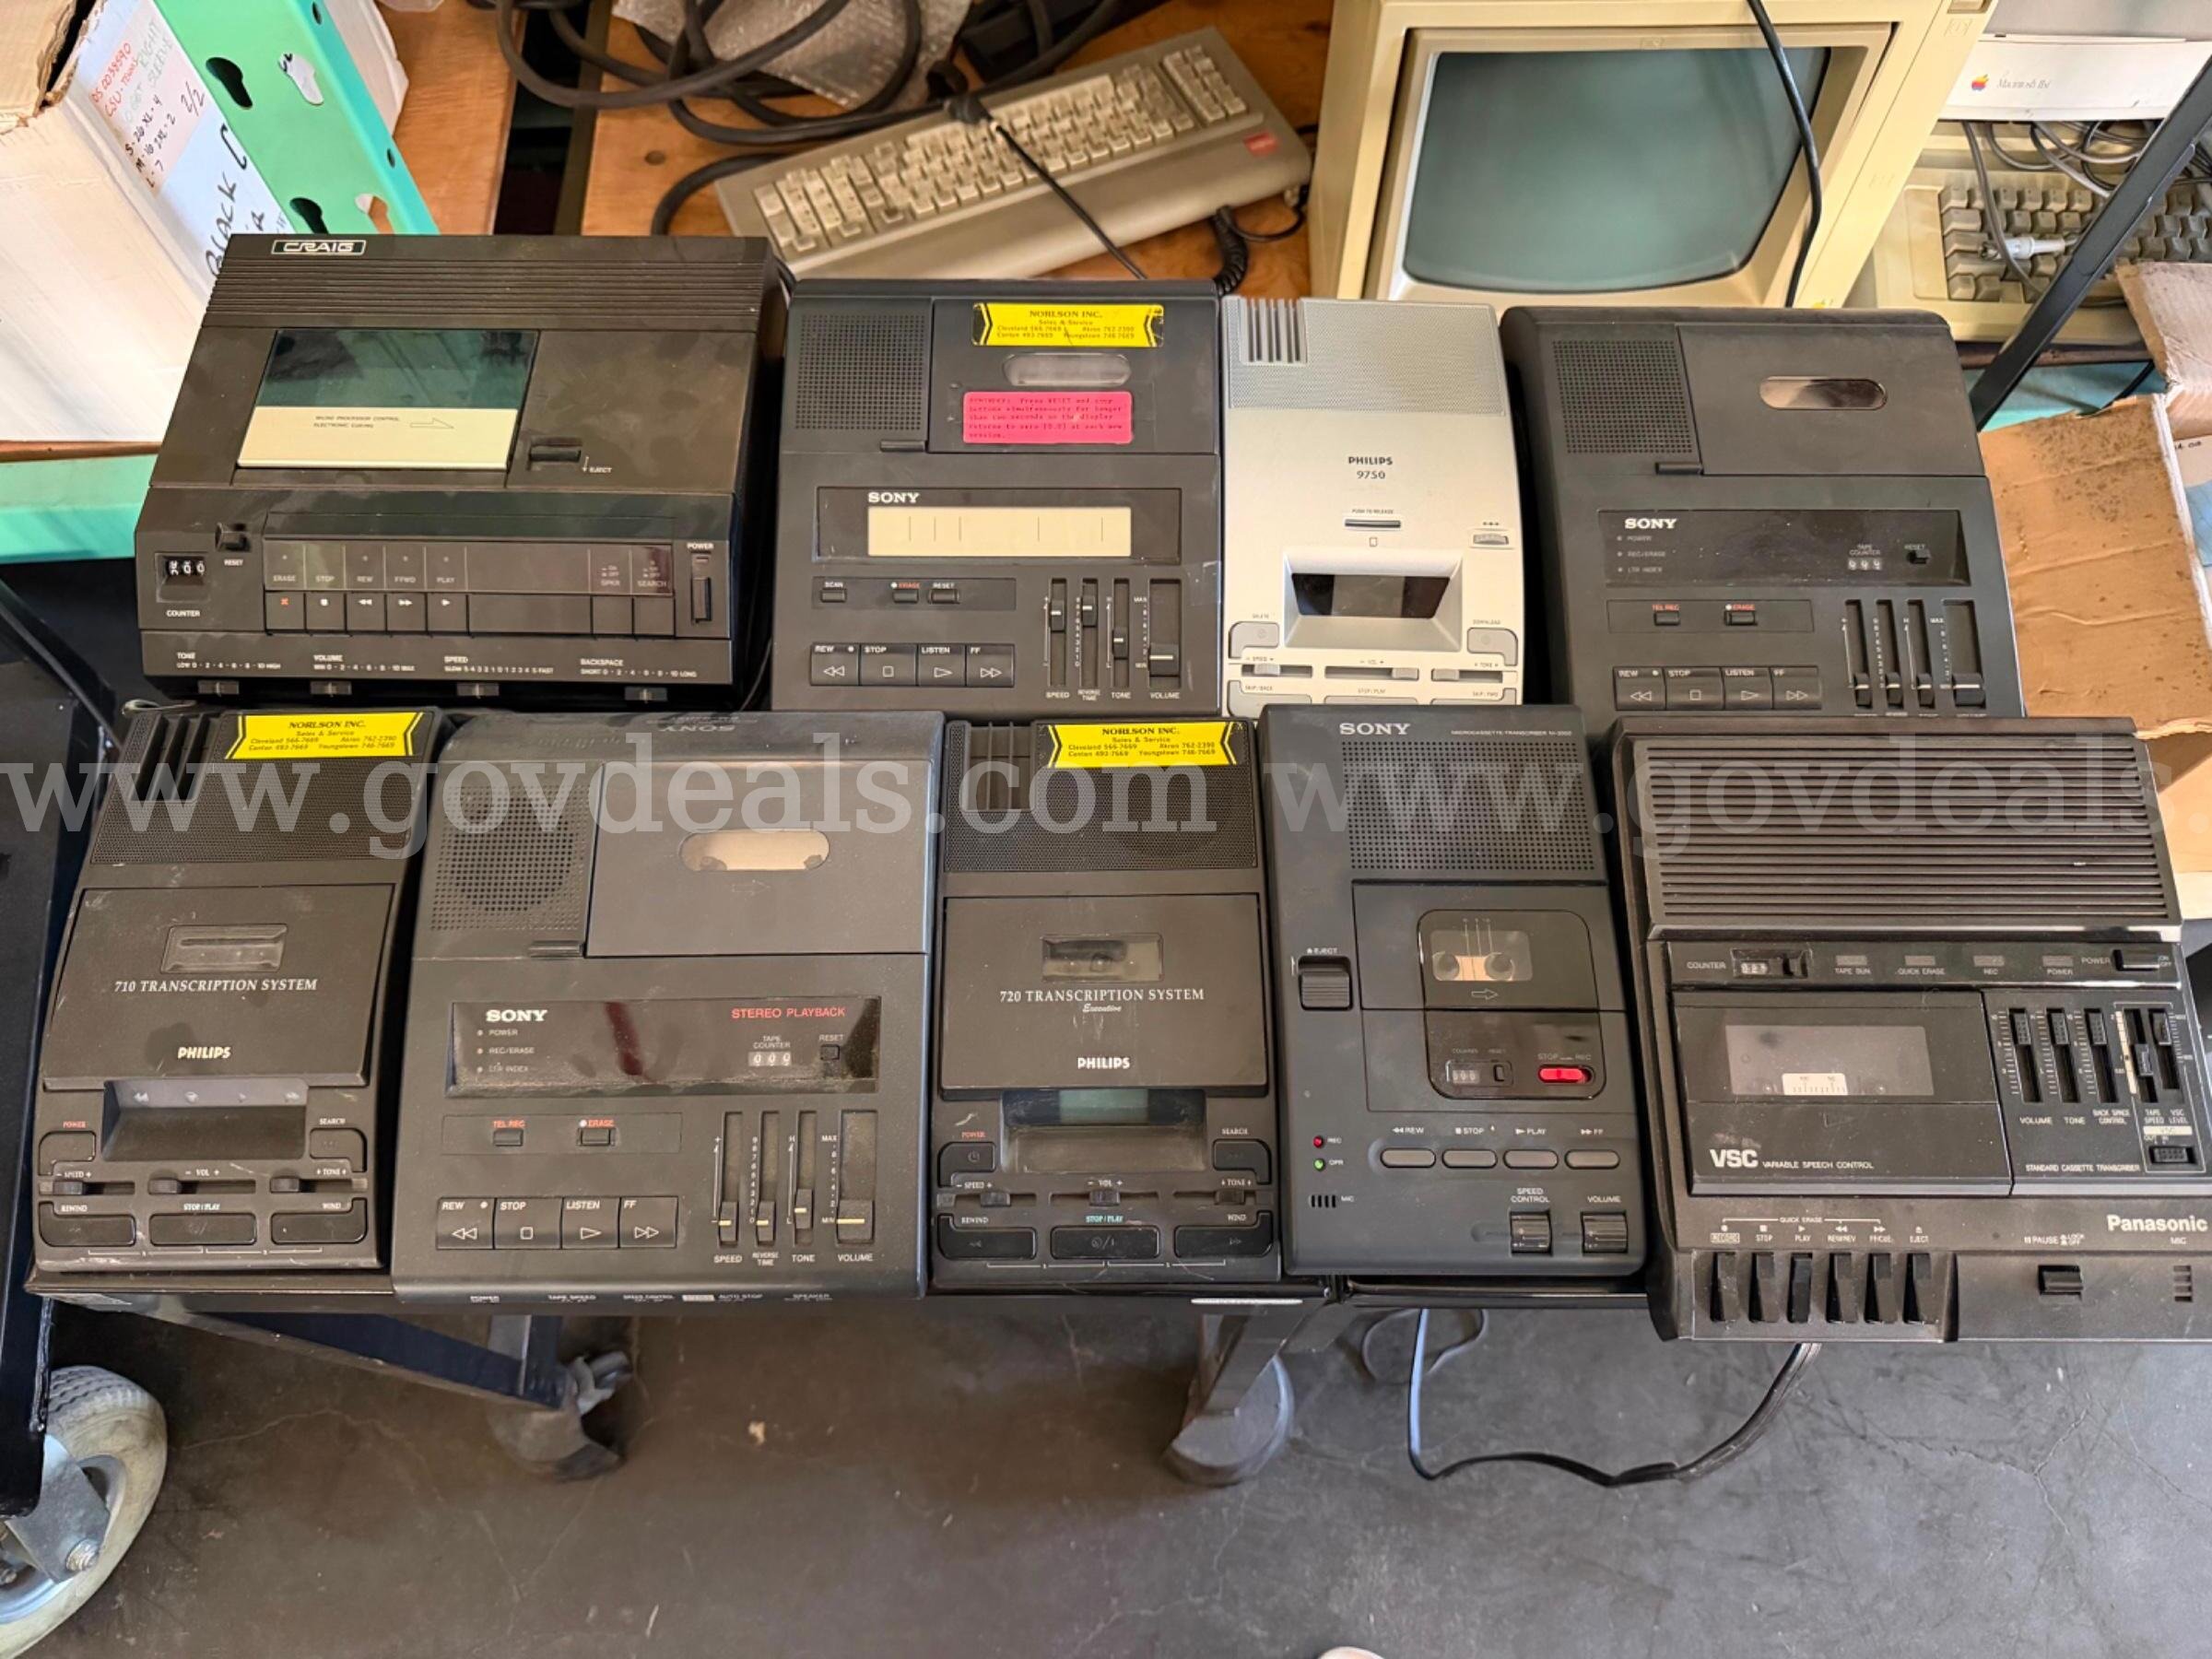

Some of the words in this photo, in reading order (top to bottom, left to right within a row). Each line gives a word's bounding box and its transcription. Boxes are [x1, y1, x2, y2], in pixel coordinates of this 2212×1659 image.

[282, 241, 356, 253] CRAIG
[1348, 456, 1393, 465] PHILIPS
[1357, 471, 1385, 479] 9750
[868, 492, 920, 503] SONY
[1625, 518, 1677, 529] SONY
[444, 655, 468, 664] SPEED
[581, 658, 623, 666] BACKSPACE
[1668, 669, 1690, 677] STOP
[343, 720, 366, 728] INC.
[1339, 723, 1411, 735] SONY
[114, 982, 136, 993] 710
[140, 980, 257, 993] TRANSCRIPTION
[261, 979, 317, 992] SYSTEM
[1000, 991, 1021, 1002] 720
[1025, 990, 1144, 1001] TRANSCRIPTION
[1148, 988, 1204, 1000] SYSTEM
[486, 1009, 547, 1021] SONY
[731, 1007, 782, 1018] STEREO
[786, 1006, 846, 1018] PLAYBACK
[178, 1047, 231, 1059] PHILIPS
[1077, 1057, 1130, 1069] PHILIPS
[588, 1119, 615, 1127] ERASE
[1710, 1150, 1759, 1168] VSC
[1836, 1161, 1875, 1170] CONTROL
[441, 1201, 465, 1210] REW
[500, 1201, 526, 1210] STOP
[566, 1200, 601, 1209] LISTEN
[623, 1200, 636, 1208] FF
[2107, 1215, 2208, 1231] Panasonic
[713, 1255, 743, 1264] SPEED
[792, 1253, 816, 1262] TONE
[837, 1253, 874, 1262] VOLUME
